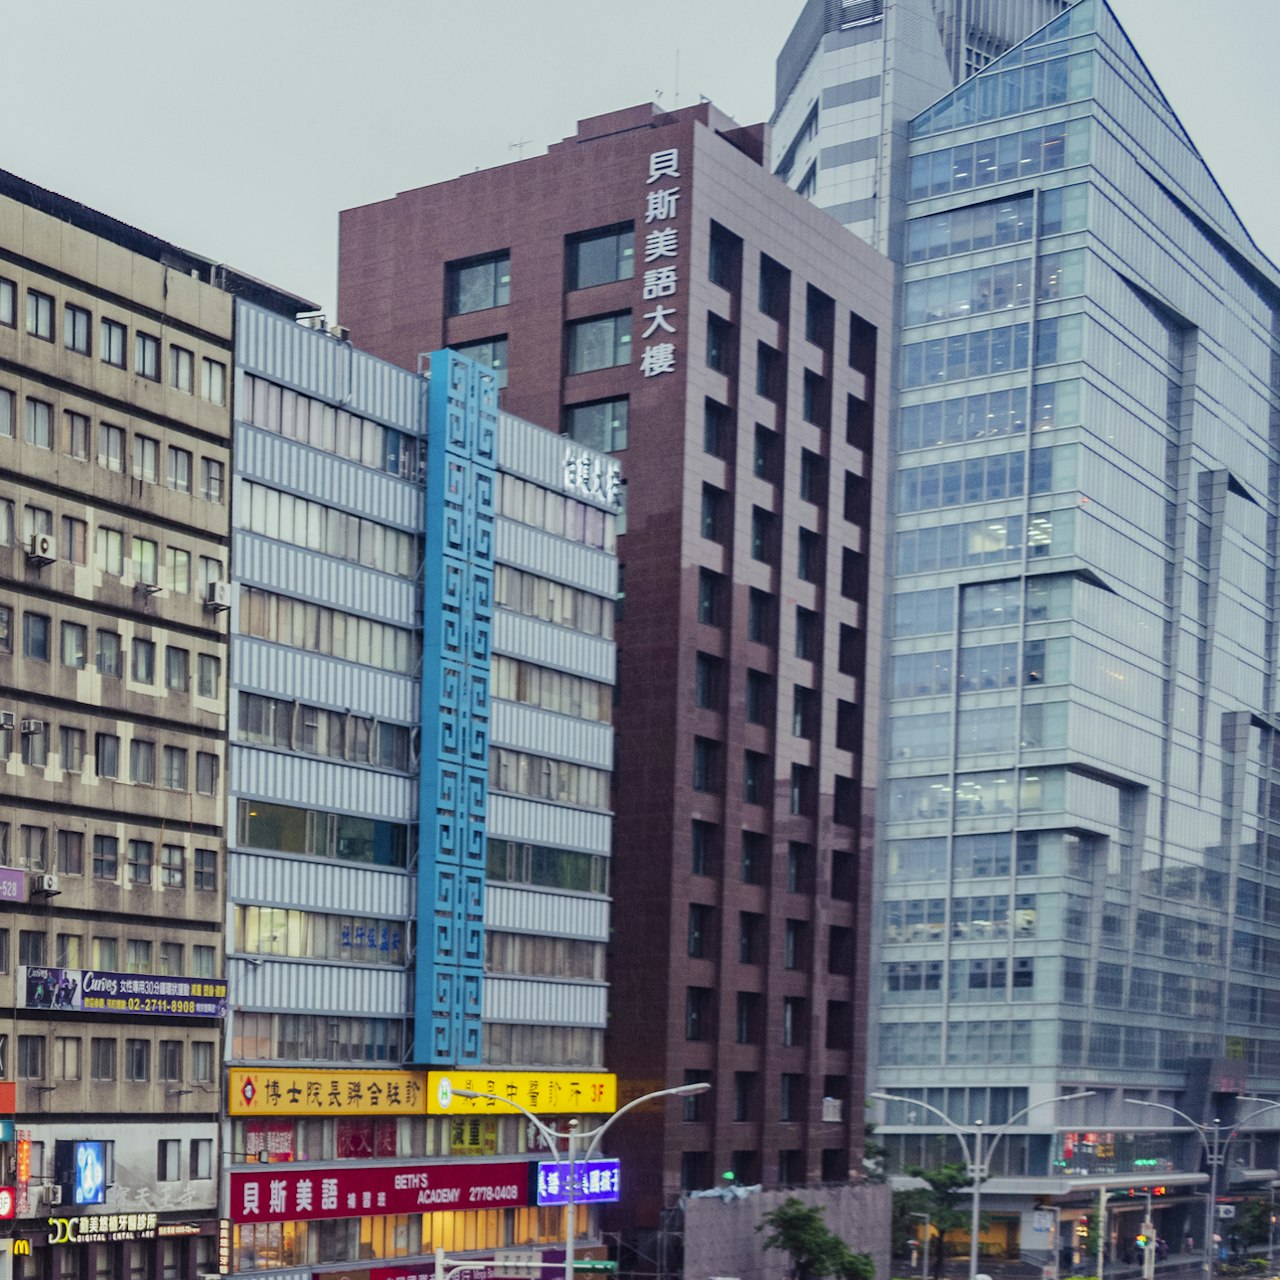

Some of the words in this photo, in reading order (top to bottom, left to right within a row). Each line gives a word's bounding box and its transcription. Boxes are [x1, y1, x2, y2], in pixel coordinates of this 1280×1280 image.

[640, 147, 681, 380] 貝斯美語大樓
[82, 971, 118, 996] Curves
[127, 997, 196, 1014] 02-2711-8908
[243, 1177, 339, 1215] 貝斯美語
[394, 1173, 429, 1191] BETH'S
[417, 1187, 461, 1205] ACADEMY
[468, 1185, 519, 1202] 2778-0408
